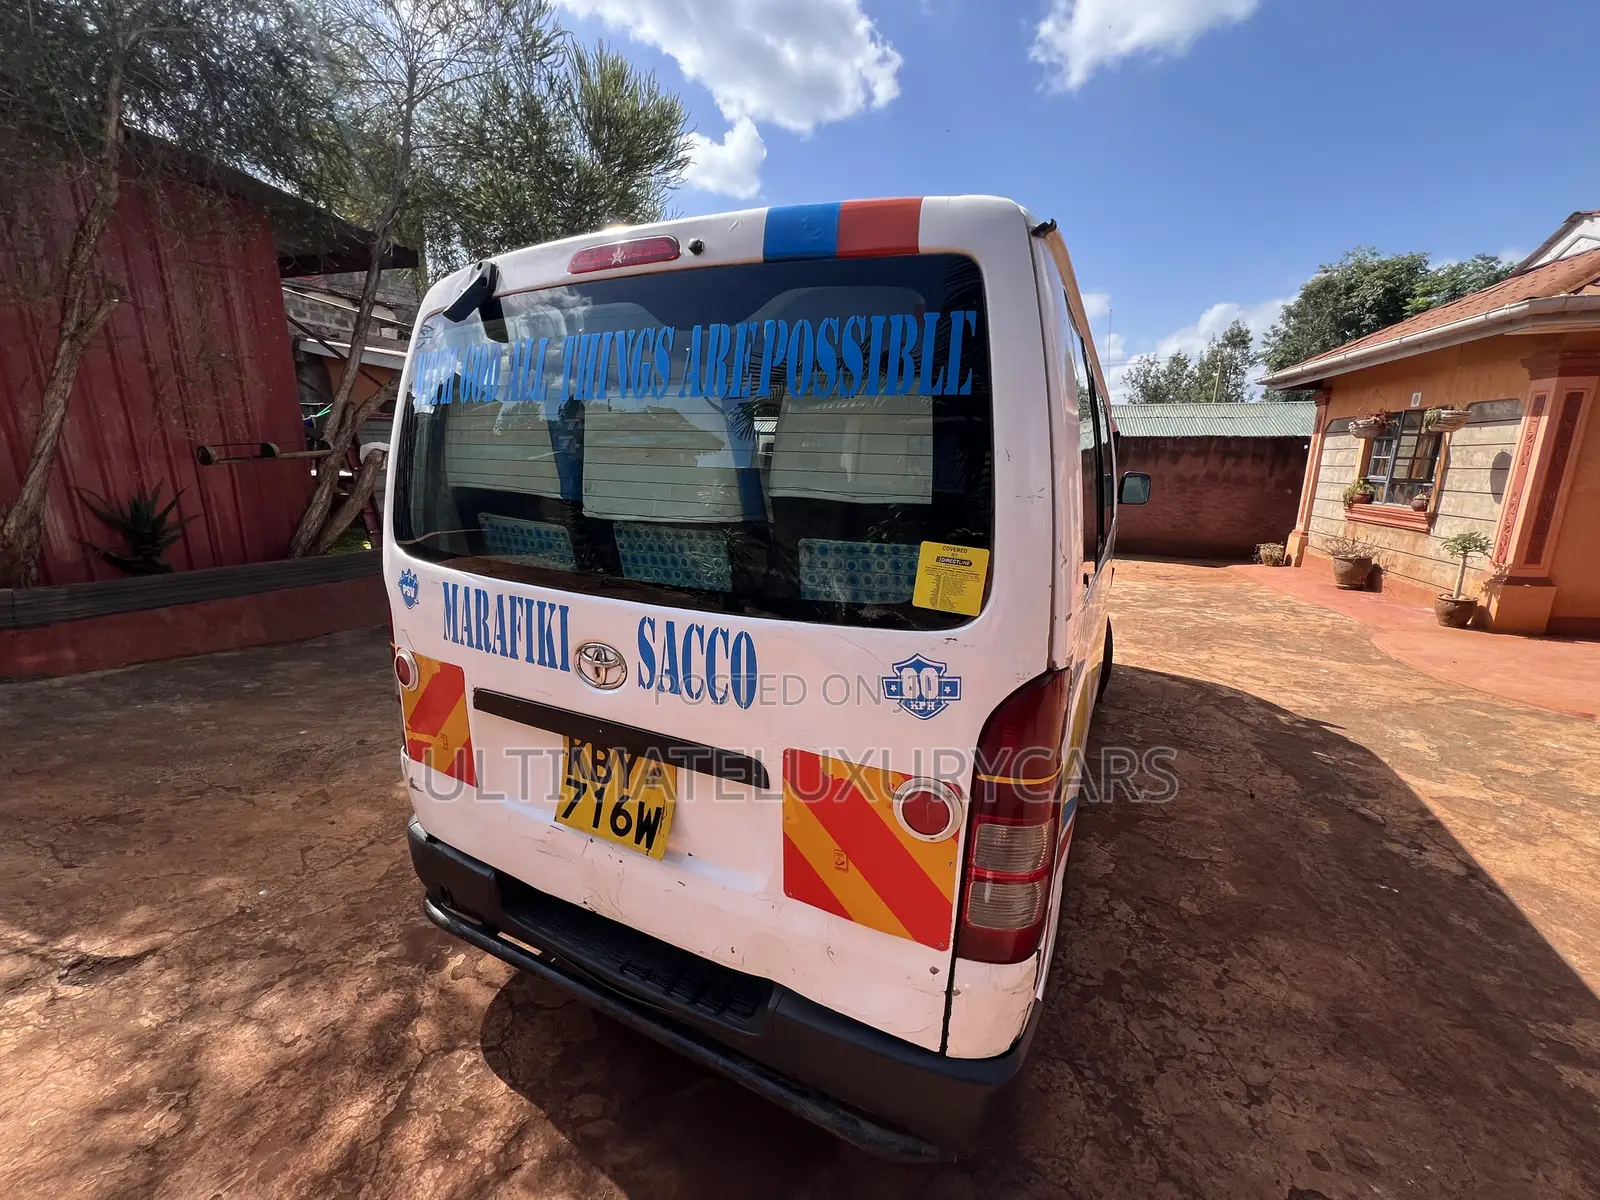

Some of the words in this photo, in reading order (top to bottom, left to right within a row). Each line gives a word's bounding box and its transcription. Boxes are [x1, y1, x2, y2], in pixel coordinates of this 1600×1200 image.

[504, 337, 549, 401] ALL
[561, 325, 675, 400] THINGS
[679, 323, 757, 398] ARE
[757, 310, 977, 400] POSSIBLE
[402, 584, 414, 597] PSV
[442, 581, 570, 672] MARAFIKI
[637, 616, 757, 709] SACCO
[910, 700, 936, 711] KPH
[567, 735, 640, 790] KBY
[562, 778, 662, 850] 716W
